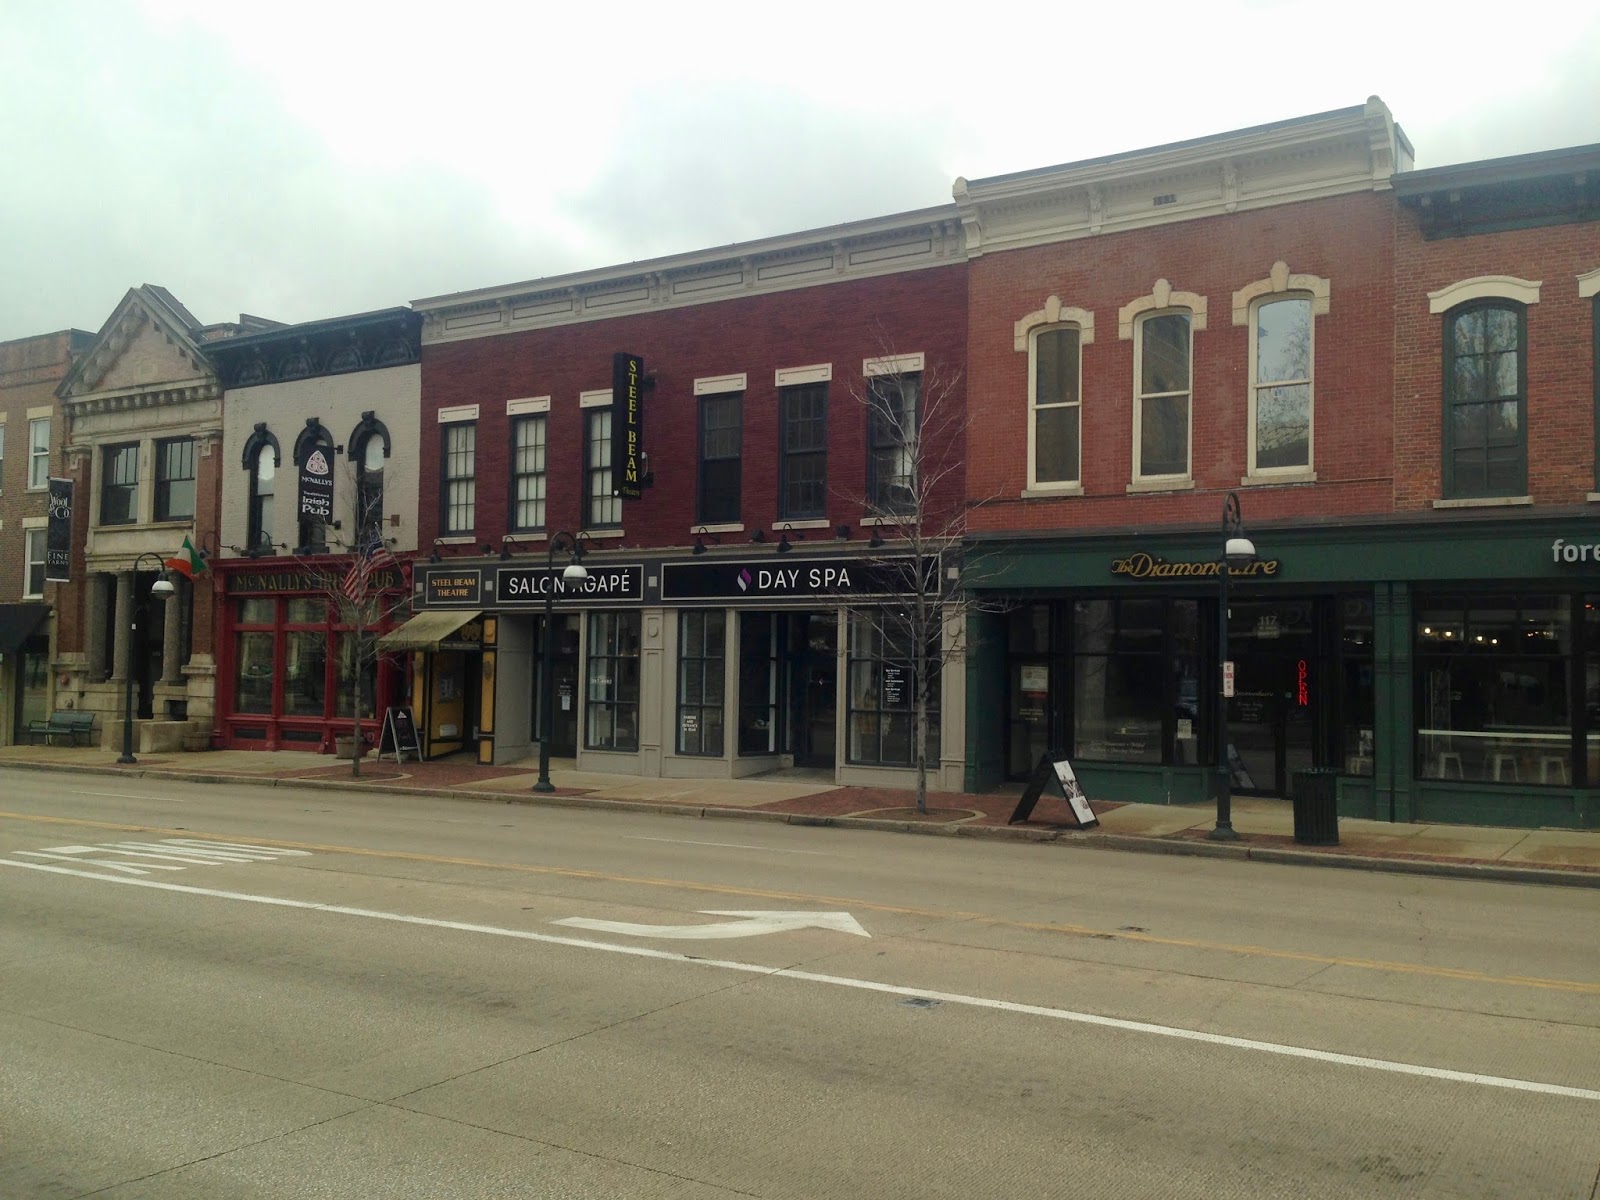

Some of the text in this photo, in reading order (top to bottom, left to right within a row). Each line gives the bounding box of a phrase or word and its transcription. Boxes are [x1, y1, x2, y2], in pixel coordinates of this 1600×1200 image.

[625, 360, 638, 483] STEEL BEAM
[49, 491, 68, 508] Wool
[302, 496, 330, 506] Irish
[302, 504, 330, 516] Pub
[47, 551, 69, 561] FINE
[1112, 558, 1134, 574] The
[431, 578, 476, 587] STEEL BEAM
[508, 568, 630, 594] SALON GAPÉ
[758, 568, 851, 589] DAY SPA
[437, 588, 469, 597] THEATRE
[1297, 660, 1308, 706] OPEN
